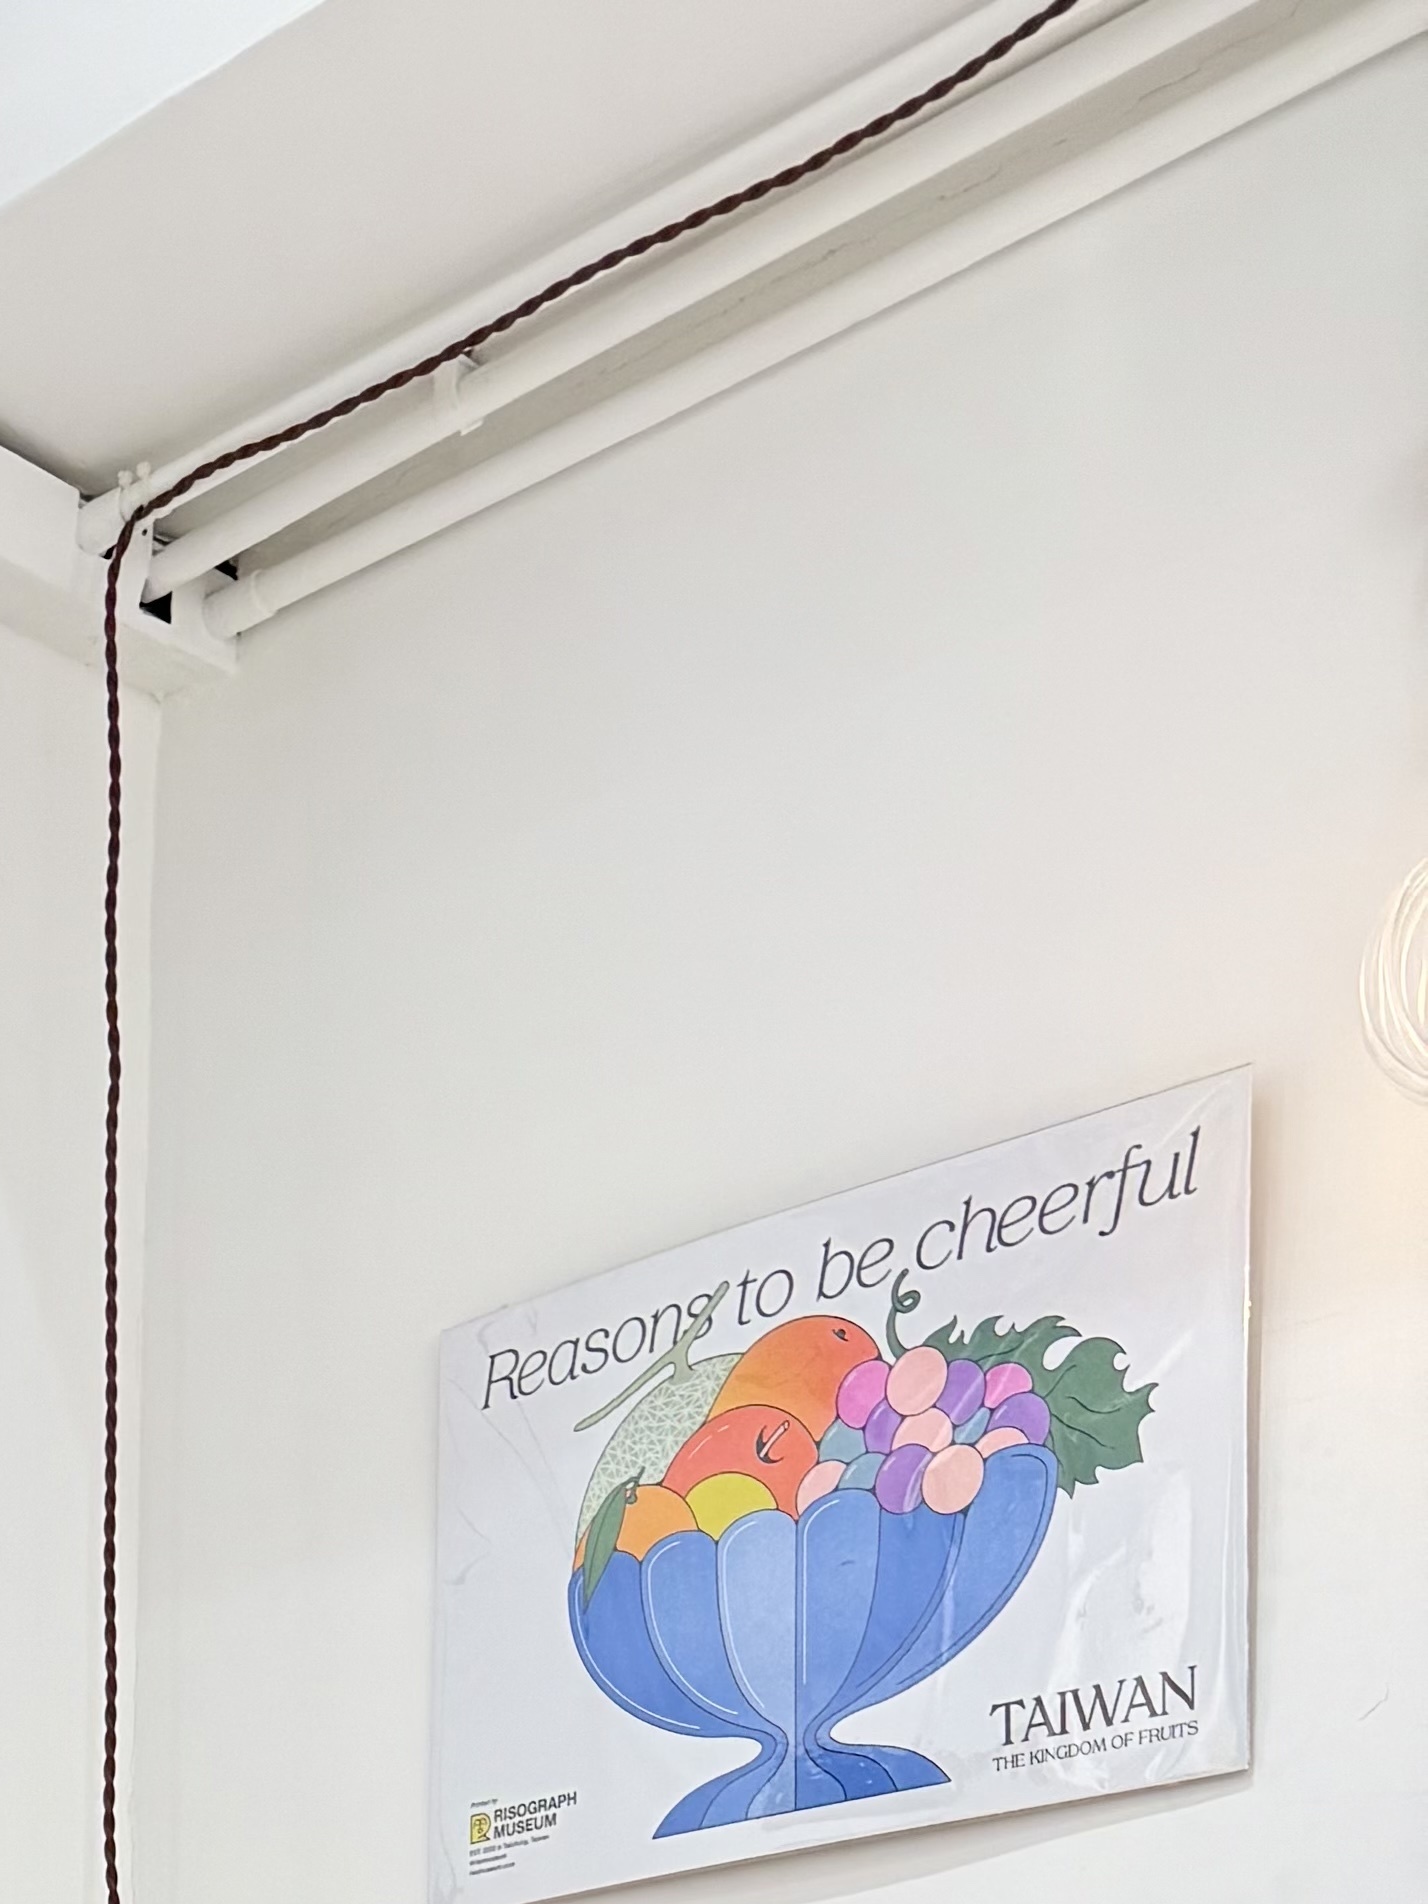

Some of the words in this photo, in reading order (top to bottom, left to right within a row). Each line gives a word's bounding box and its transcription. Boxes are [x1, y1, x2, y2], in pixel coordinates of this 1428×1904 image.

[482, 1293, 714, 1410] Reasons
[736, 1269, 794, 1326] to
[816, 1236, 894, 1302] be
[916, 1125, 1201, 1271] cheerful
[989, 1665, 1198, 1746] TAIWAN
[993, 1753, 1026, 1771] THE
[1030, 1738, 1108, 1765] KINGDOM
[1111, 1732, 1135, 1750] OF
[1138, 1720, 1199, 1745] FRUITS
[493, 1812, 557, 1840] MUSEUM
[494, 1791, 577, 1823] RISOGRAPH
